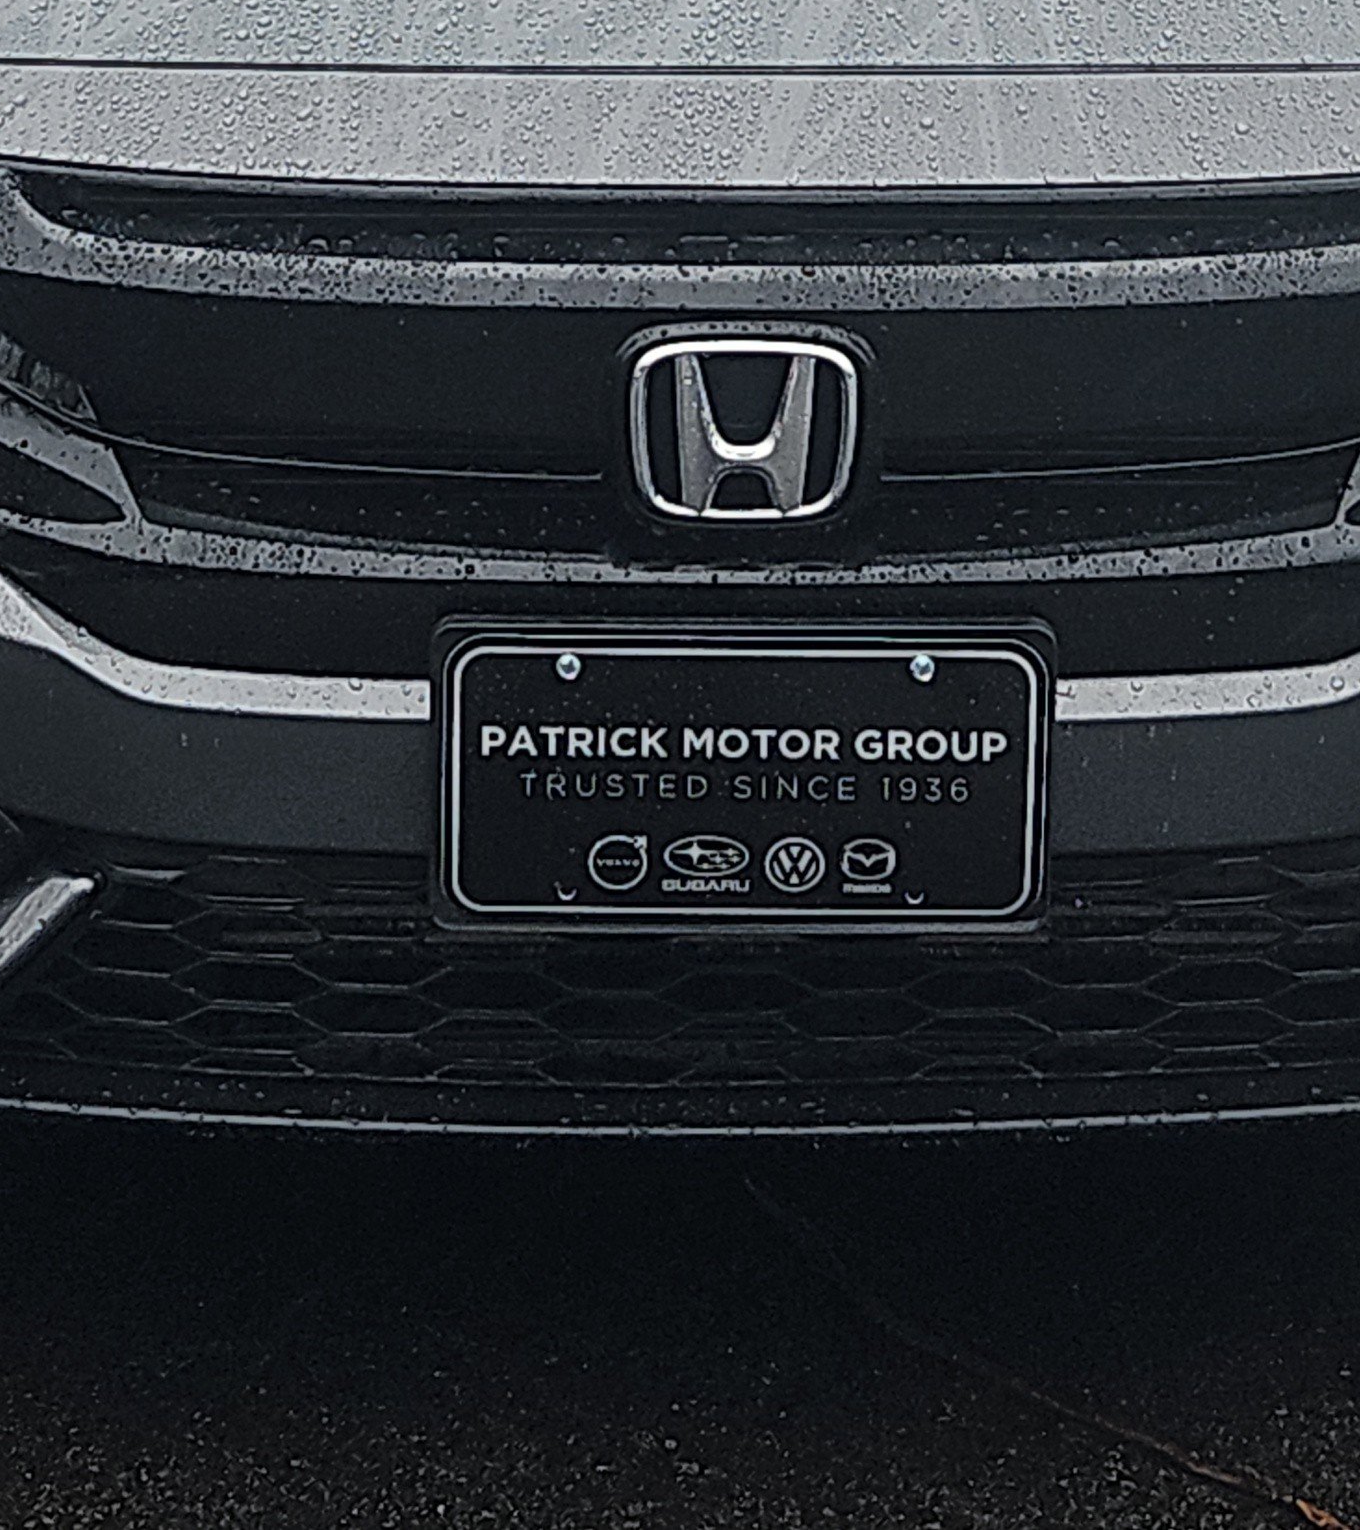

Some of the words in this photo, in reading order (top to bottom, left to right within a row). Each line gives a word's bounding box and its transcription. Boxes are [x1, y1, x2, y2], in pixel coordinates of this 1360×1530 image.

[481, 725, 669, 759] PATRICK
[683, 727, 840, 760] MOTOR
[854, 729, 1008, 762] GROUP
[520, 772, 708, 799] TRUSTED
[734, 775, 856, 801] SINCE
[882, 776, 969, 802] 1936
[661, 879, 751, 892] SUBARU
